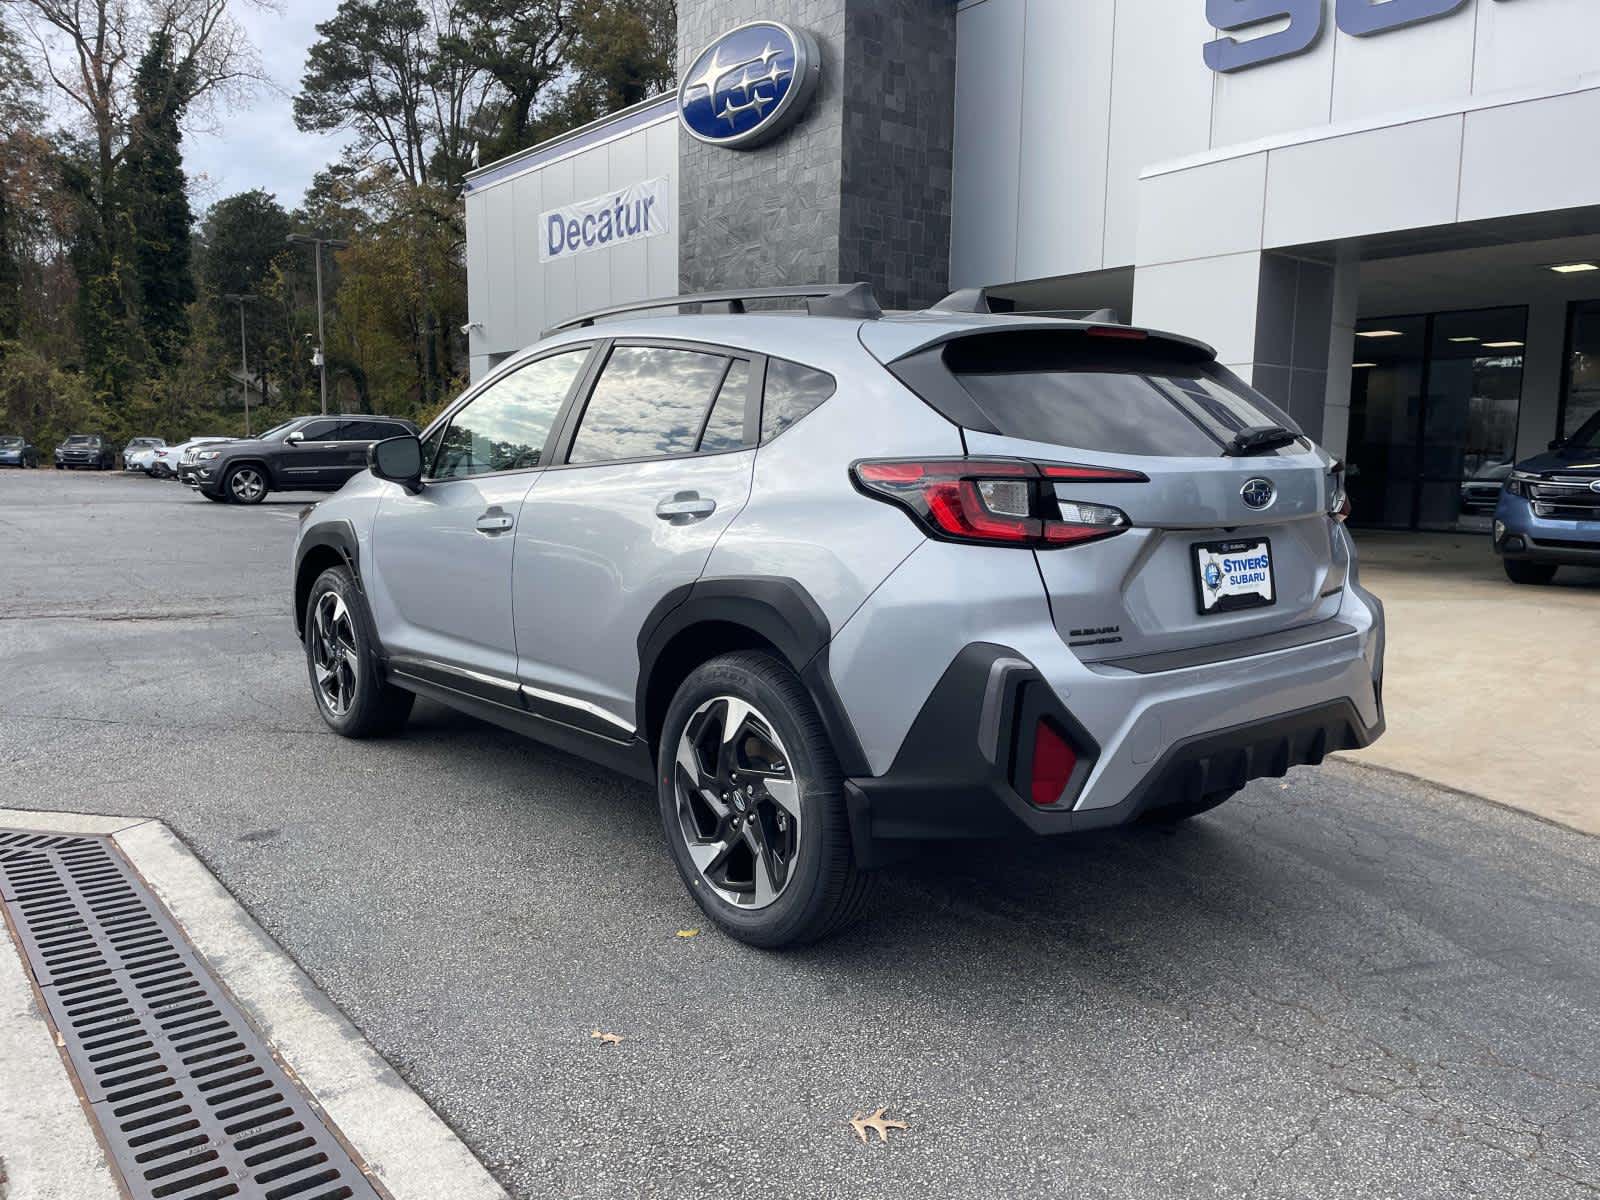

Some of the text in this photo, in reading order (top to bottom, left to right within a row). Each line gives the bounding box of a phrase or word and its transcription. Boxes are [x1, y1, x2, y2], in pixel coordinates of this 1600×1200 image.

[548, 195, 655, 256] Decatur
[1223, 555, 1269, 573] STIVERS
[1230, 572, 1266, 585] SUBARU
